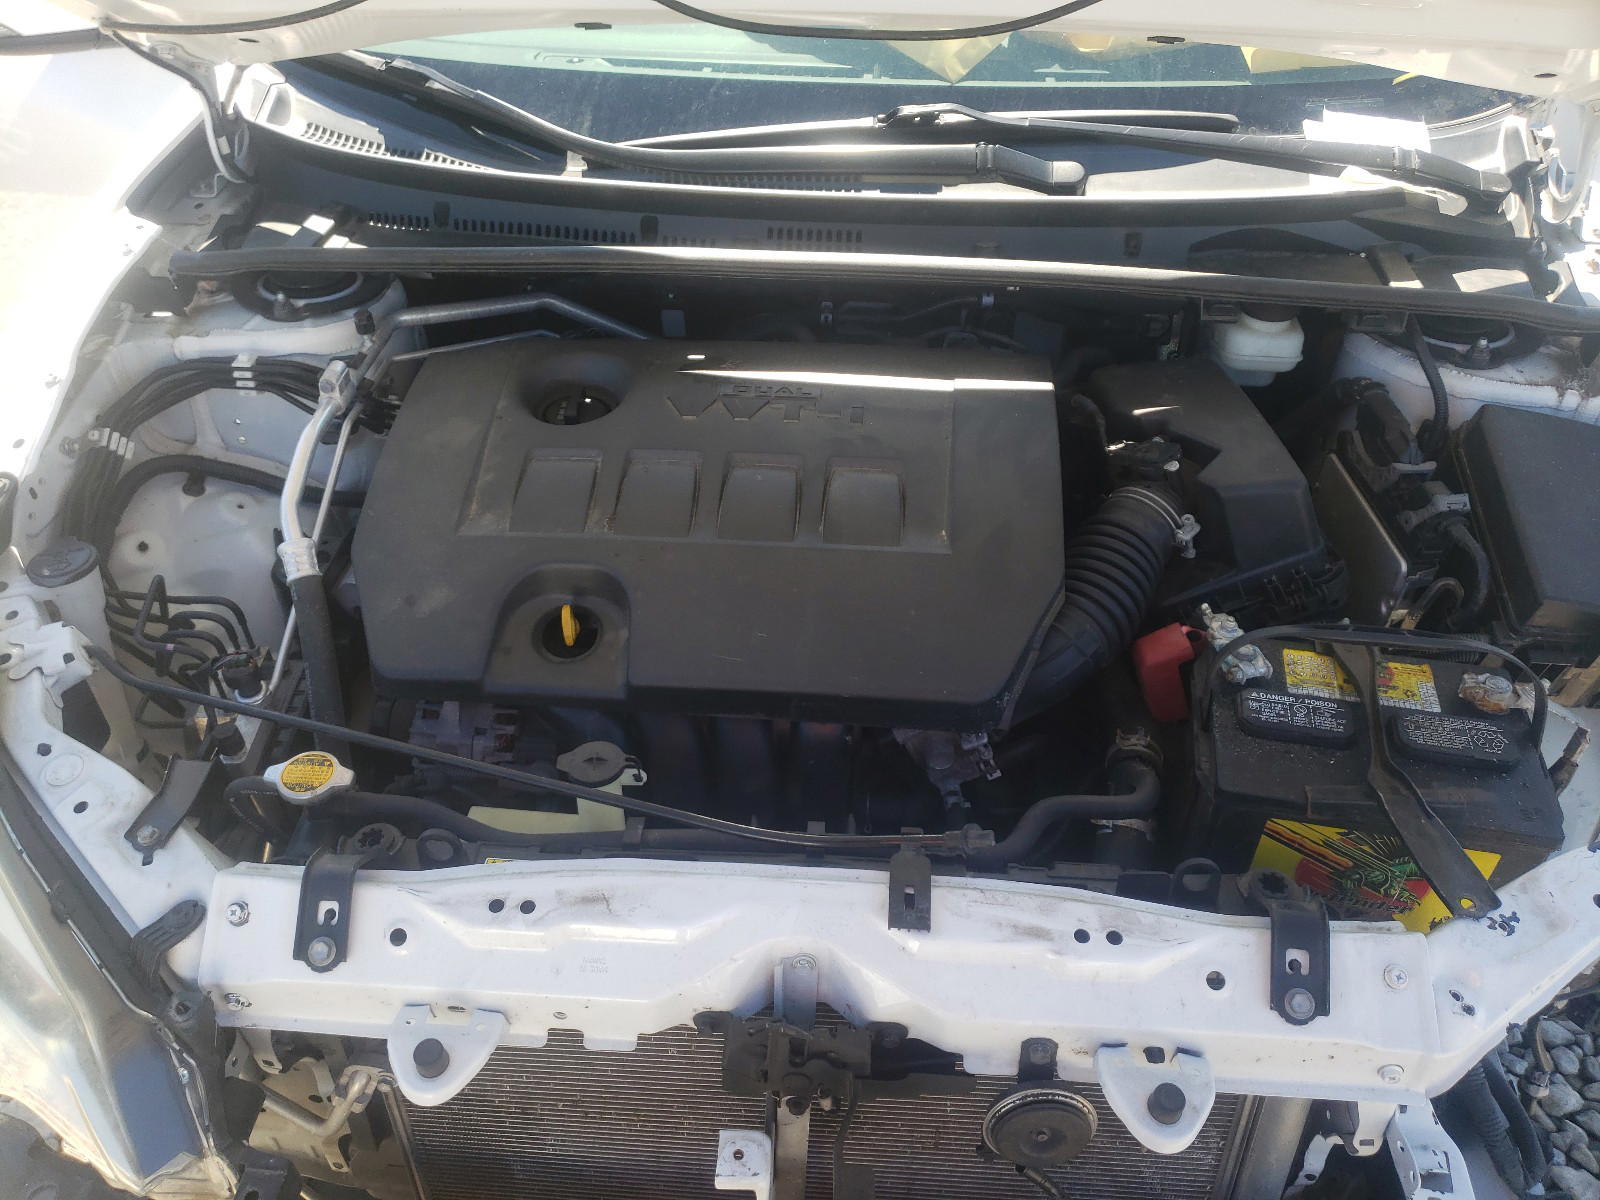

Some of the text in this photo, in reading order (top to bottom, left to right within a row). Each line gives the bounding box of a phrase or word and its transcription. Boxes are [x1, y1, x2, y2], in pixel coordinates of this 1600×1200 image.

[733, 384, 812, 396] DUAL
[1259, 692, 1296, 703] DANGER
[1304, 698, 1338, 709] POISON
